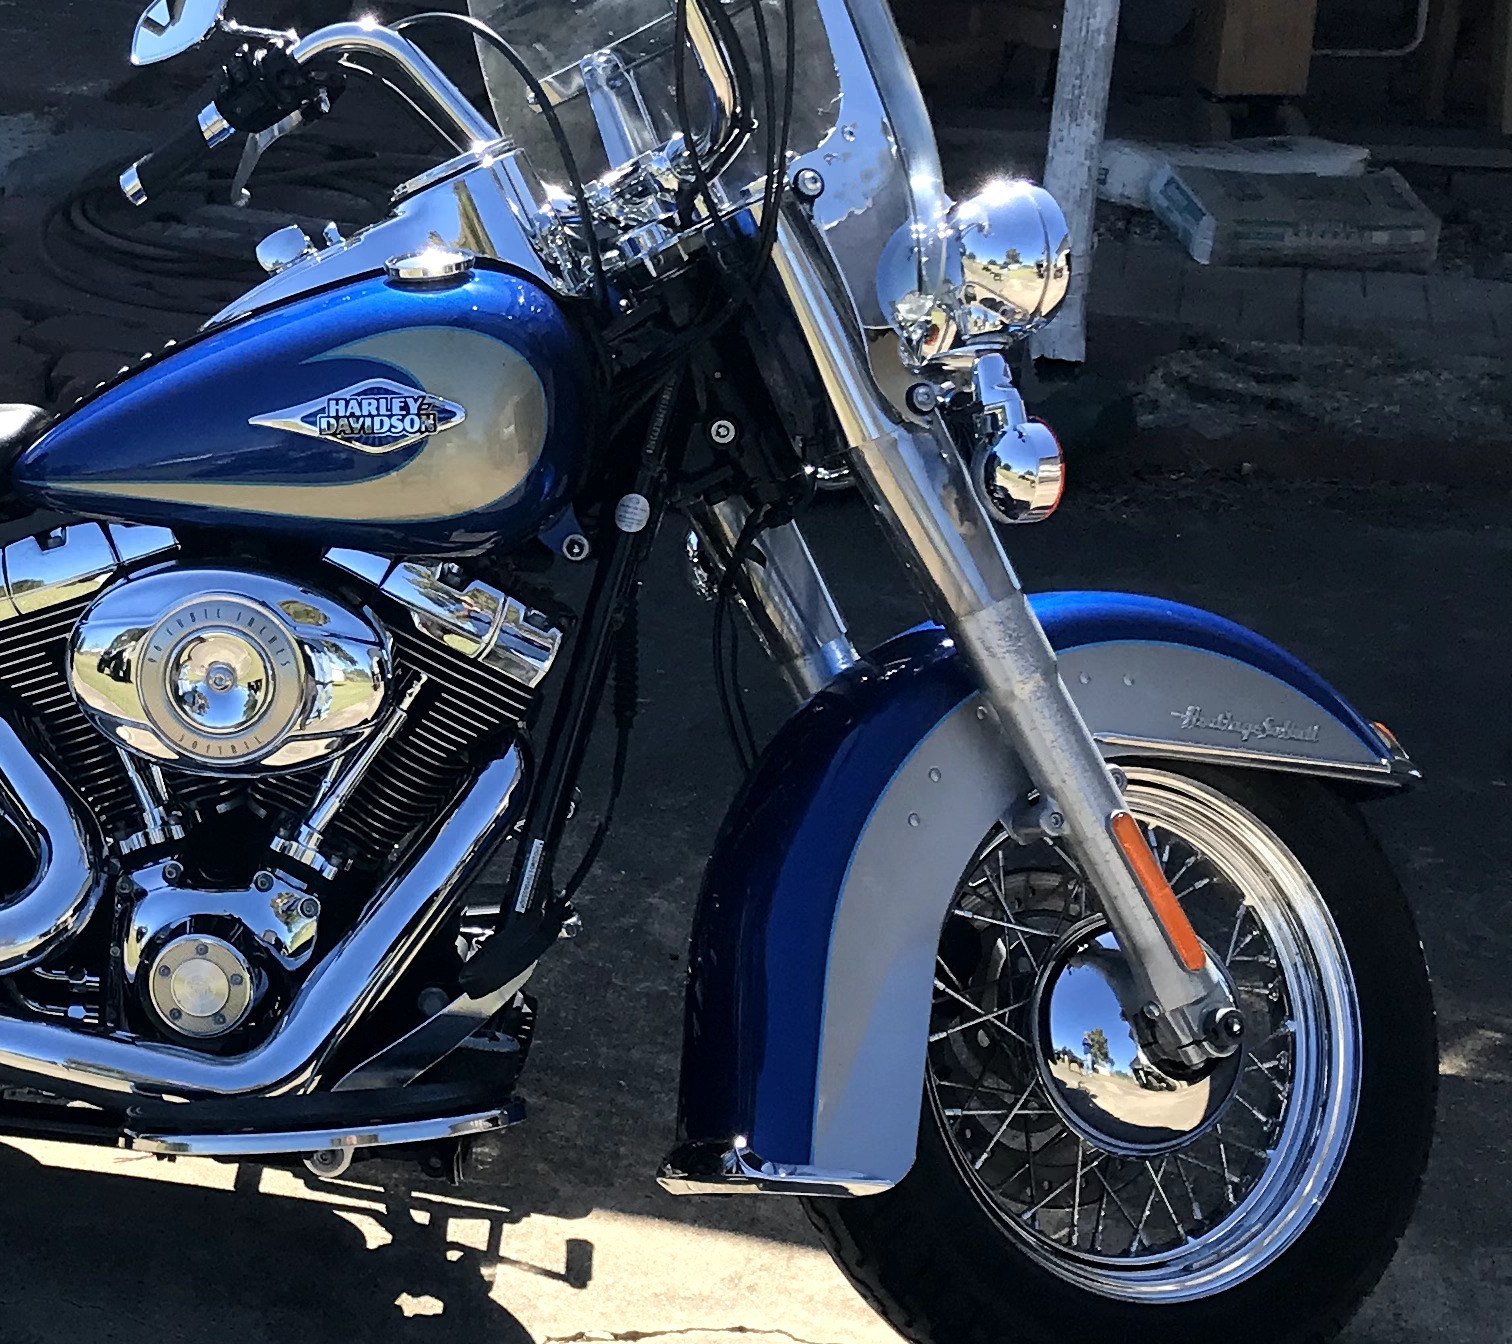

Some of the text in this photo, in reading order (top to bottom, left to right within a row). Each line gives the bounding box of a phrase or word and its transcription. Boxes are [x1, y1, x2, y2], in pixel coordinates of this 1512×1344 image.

[329, 396, 429, 415] HARLEY-
[320, 415, 436, 434] DAVIDSON
[166, 608, 221, 636] CUBIC
[236, 611, 291, 666] INCHES
